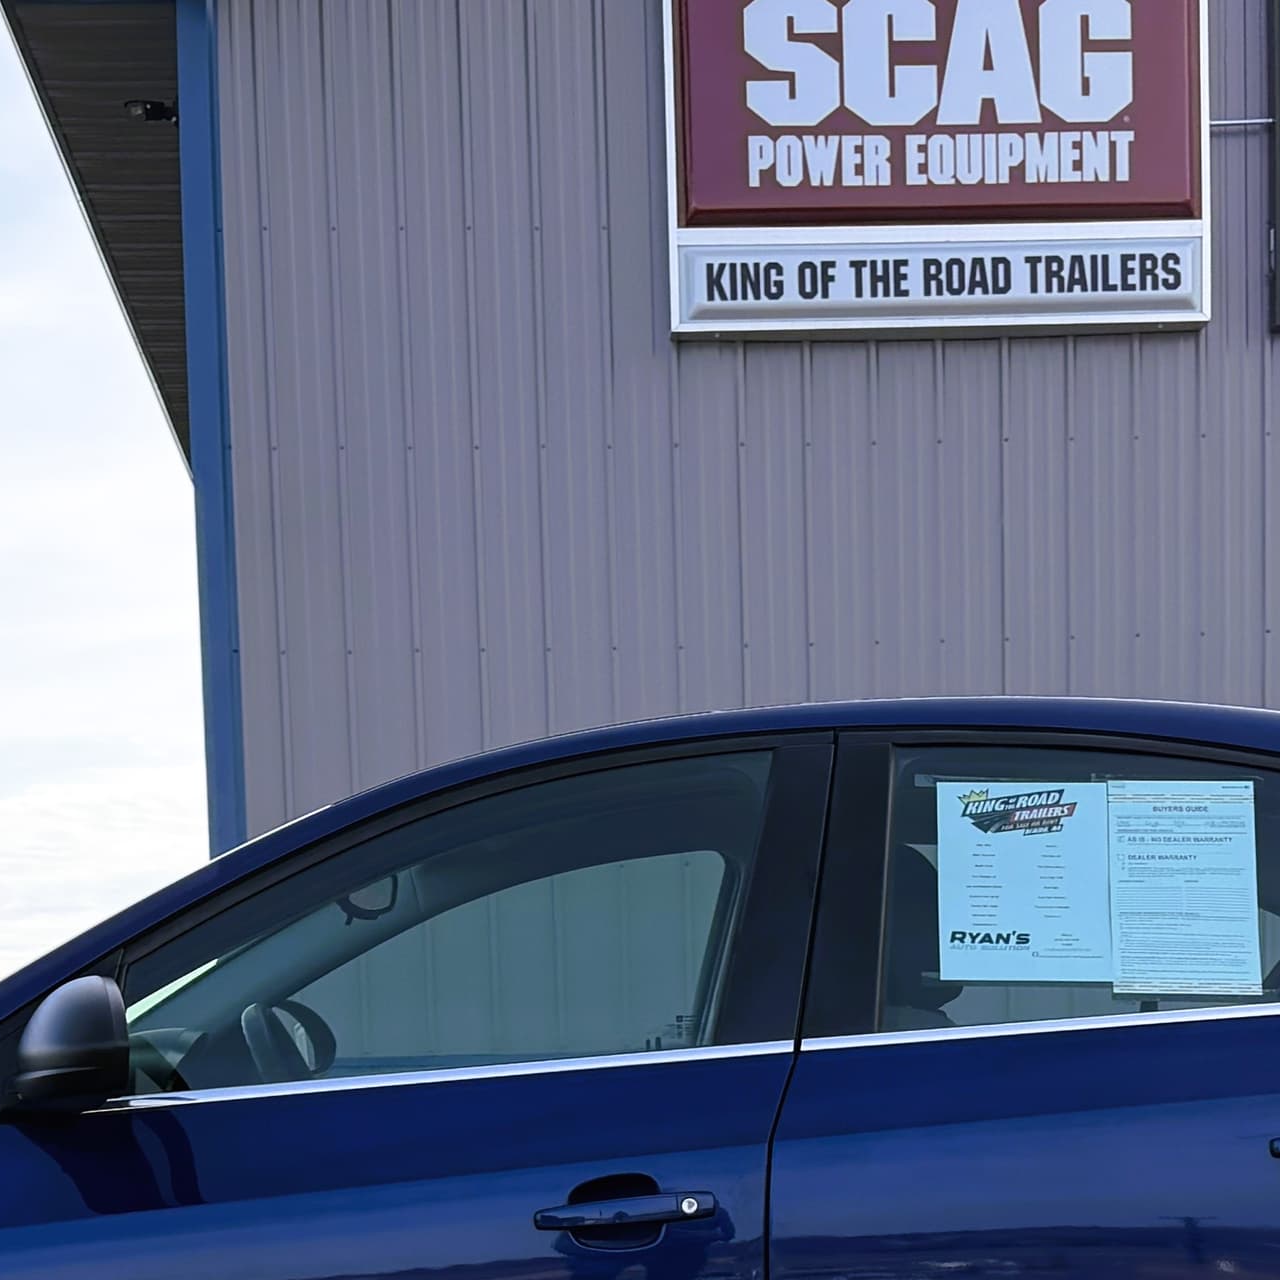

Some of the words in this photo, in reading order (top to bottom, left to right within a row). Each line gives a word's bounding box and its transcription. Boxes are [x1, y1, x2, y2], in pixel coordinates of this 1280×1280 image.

[742, 0, 1134, 126] SCAG
[747, 135, 891, 188] POWER
[906, 131, 1135, 186] EQUIPMENT
[706, 260, 785, 302] KING
[798, 259, 837, 300] OF
[850, 258, 910, 298] THE
[923, 256, 1012, 297] ROAD
[1025, 252, 1182, 293] TRAILERS
[966, 799, 1007, 815] KING
[1016, 792, 1060, 808] ROAD
[1014, 805, 1071, 821] TRAILERS
[950, 930, 1031, 945] RYAN'S
